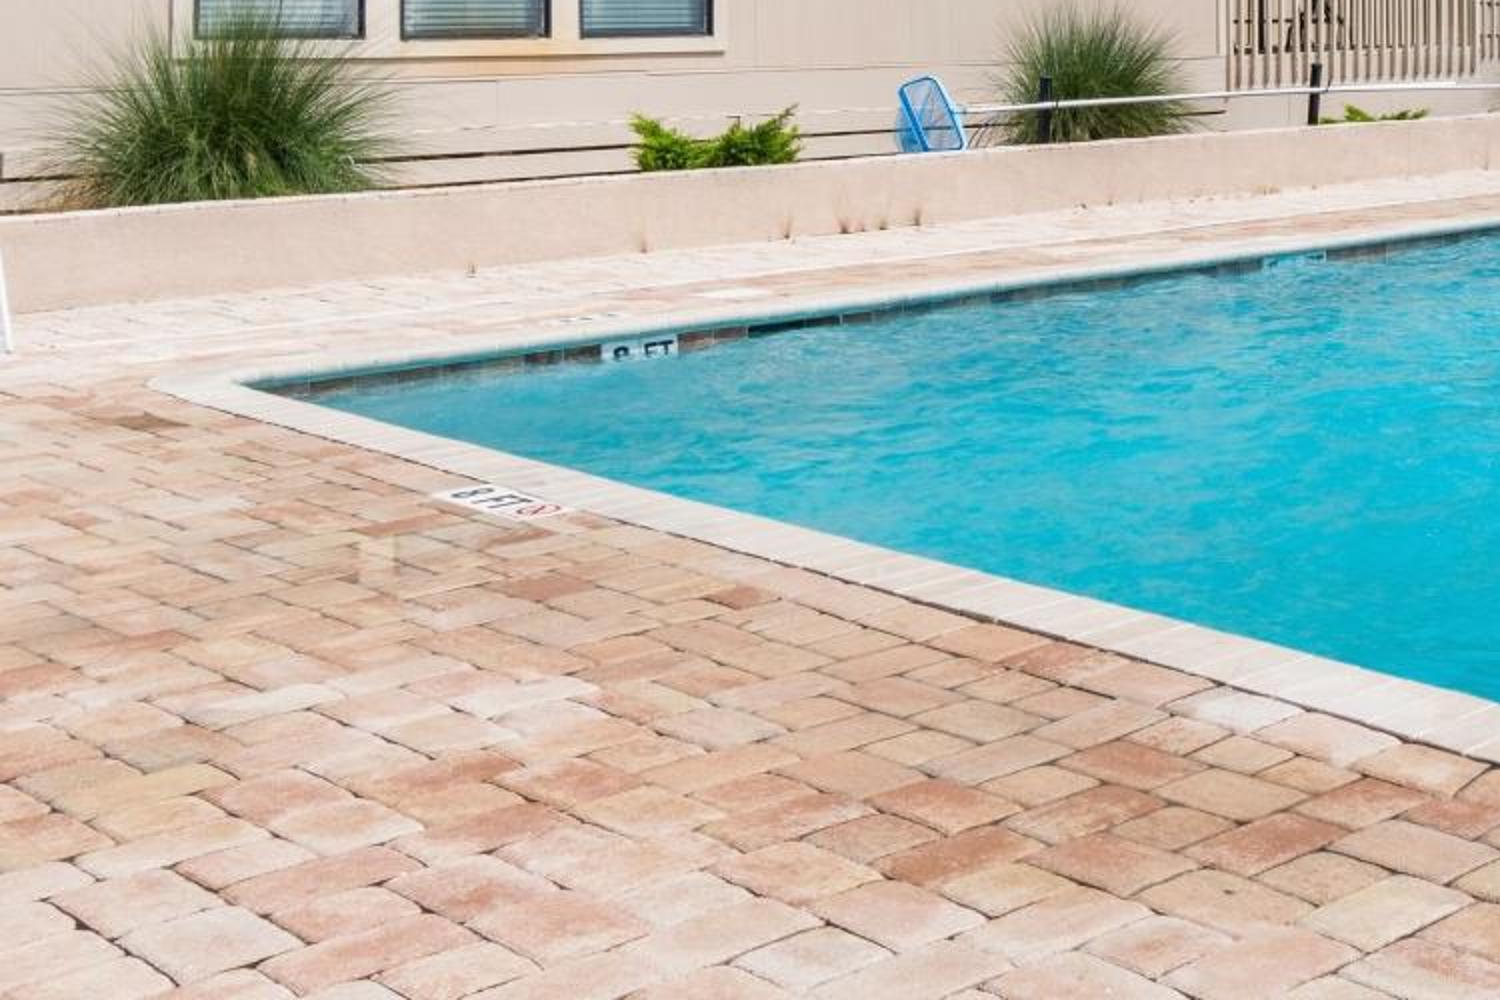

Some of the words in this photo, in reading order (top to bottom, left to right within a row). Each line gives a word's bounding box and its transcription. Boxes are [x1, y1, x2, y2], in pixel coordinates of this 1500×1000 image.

[644, 339, 674, 358] FT
[450, 487, 495, 499] 8
[470, 493, 535, 509] FT
